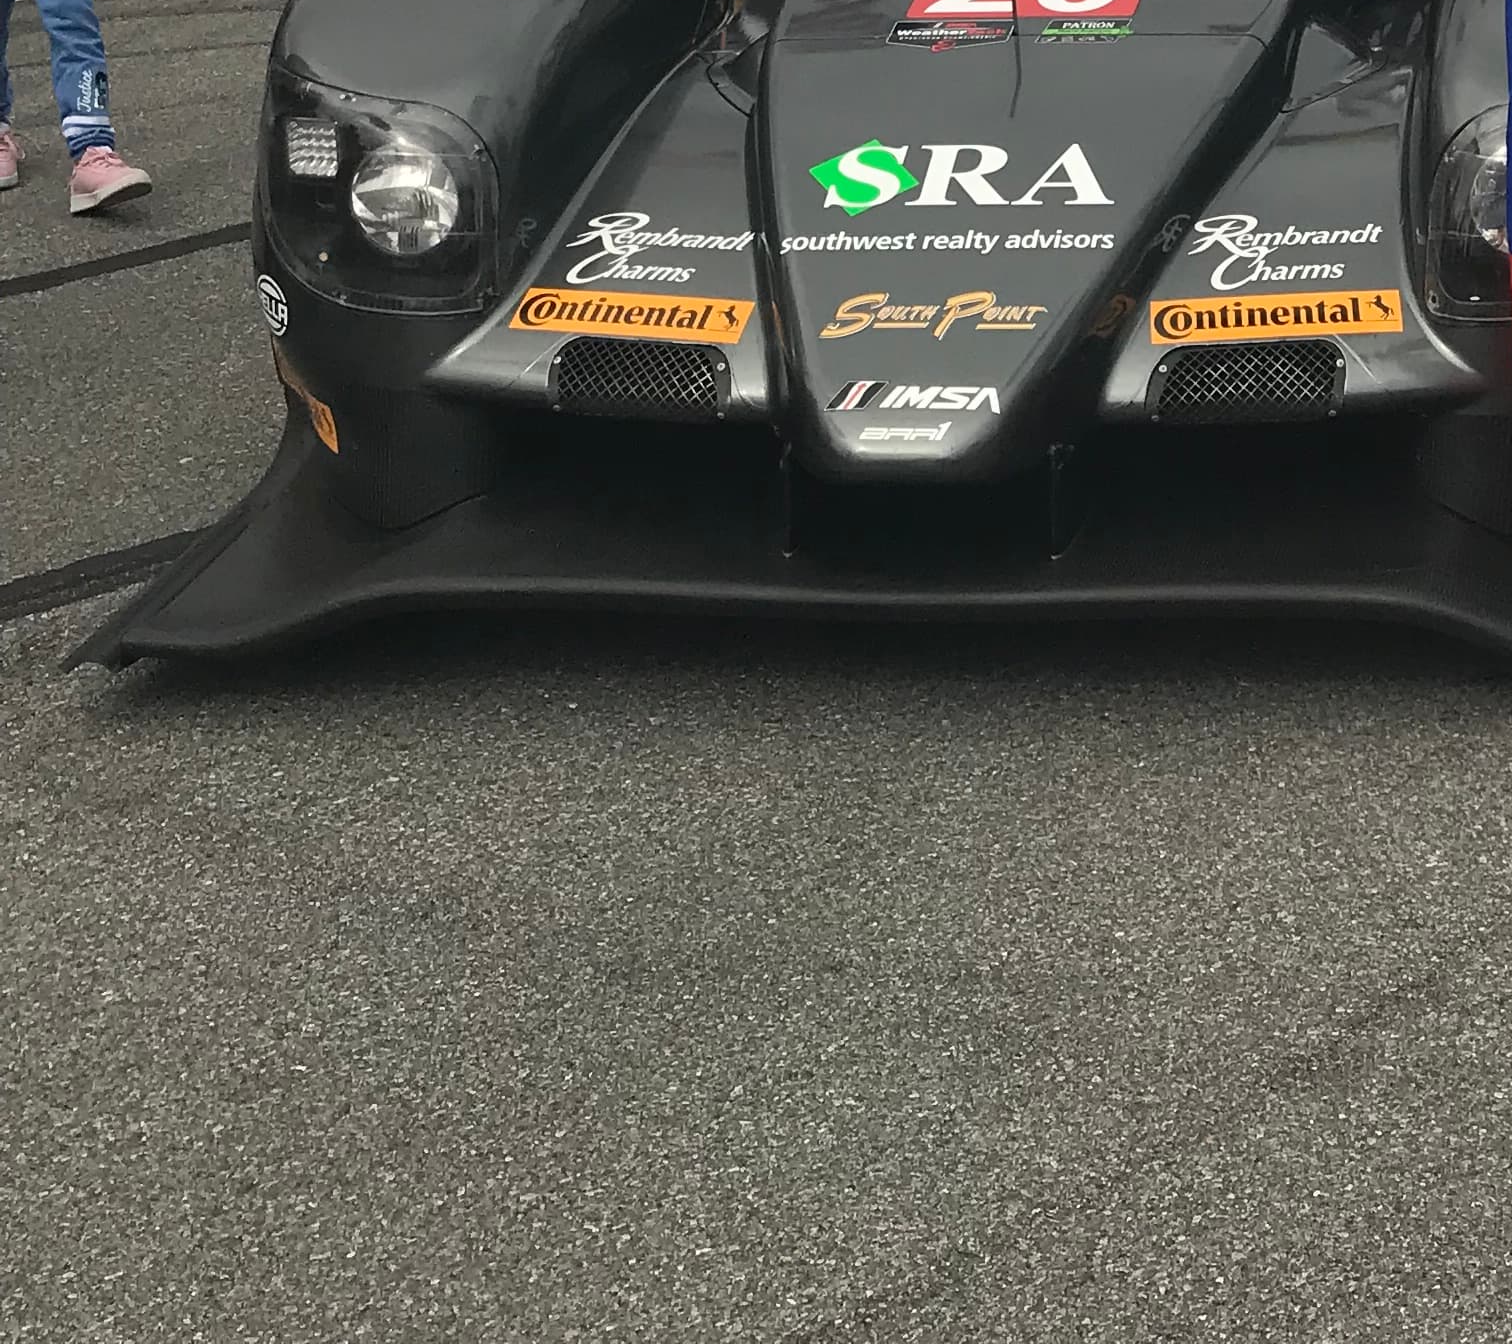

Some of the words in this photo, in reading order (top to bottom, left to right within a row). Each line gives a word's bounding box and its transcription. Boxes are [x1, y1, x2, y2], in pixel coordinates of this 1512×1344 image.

[823, 143, 1116, 209] SRA
[566, 211, 756, 256] Rembrandt
[780, 231, 917, 255] southwest
[922, 229, 1000, 255] realty
[1004, 229, 1116, 250] advisors
[1187, 214, 1384, 257] Rembrandt
[566, 244, 697, 285] Charms
[1210, 247, 1346, 291] Charms
[519, 292, 714, 330] Continental
[1154, 297, 1363, 340] Continental
[879, 385, 1001, 415] IMSA
